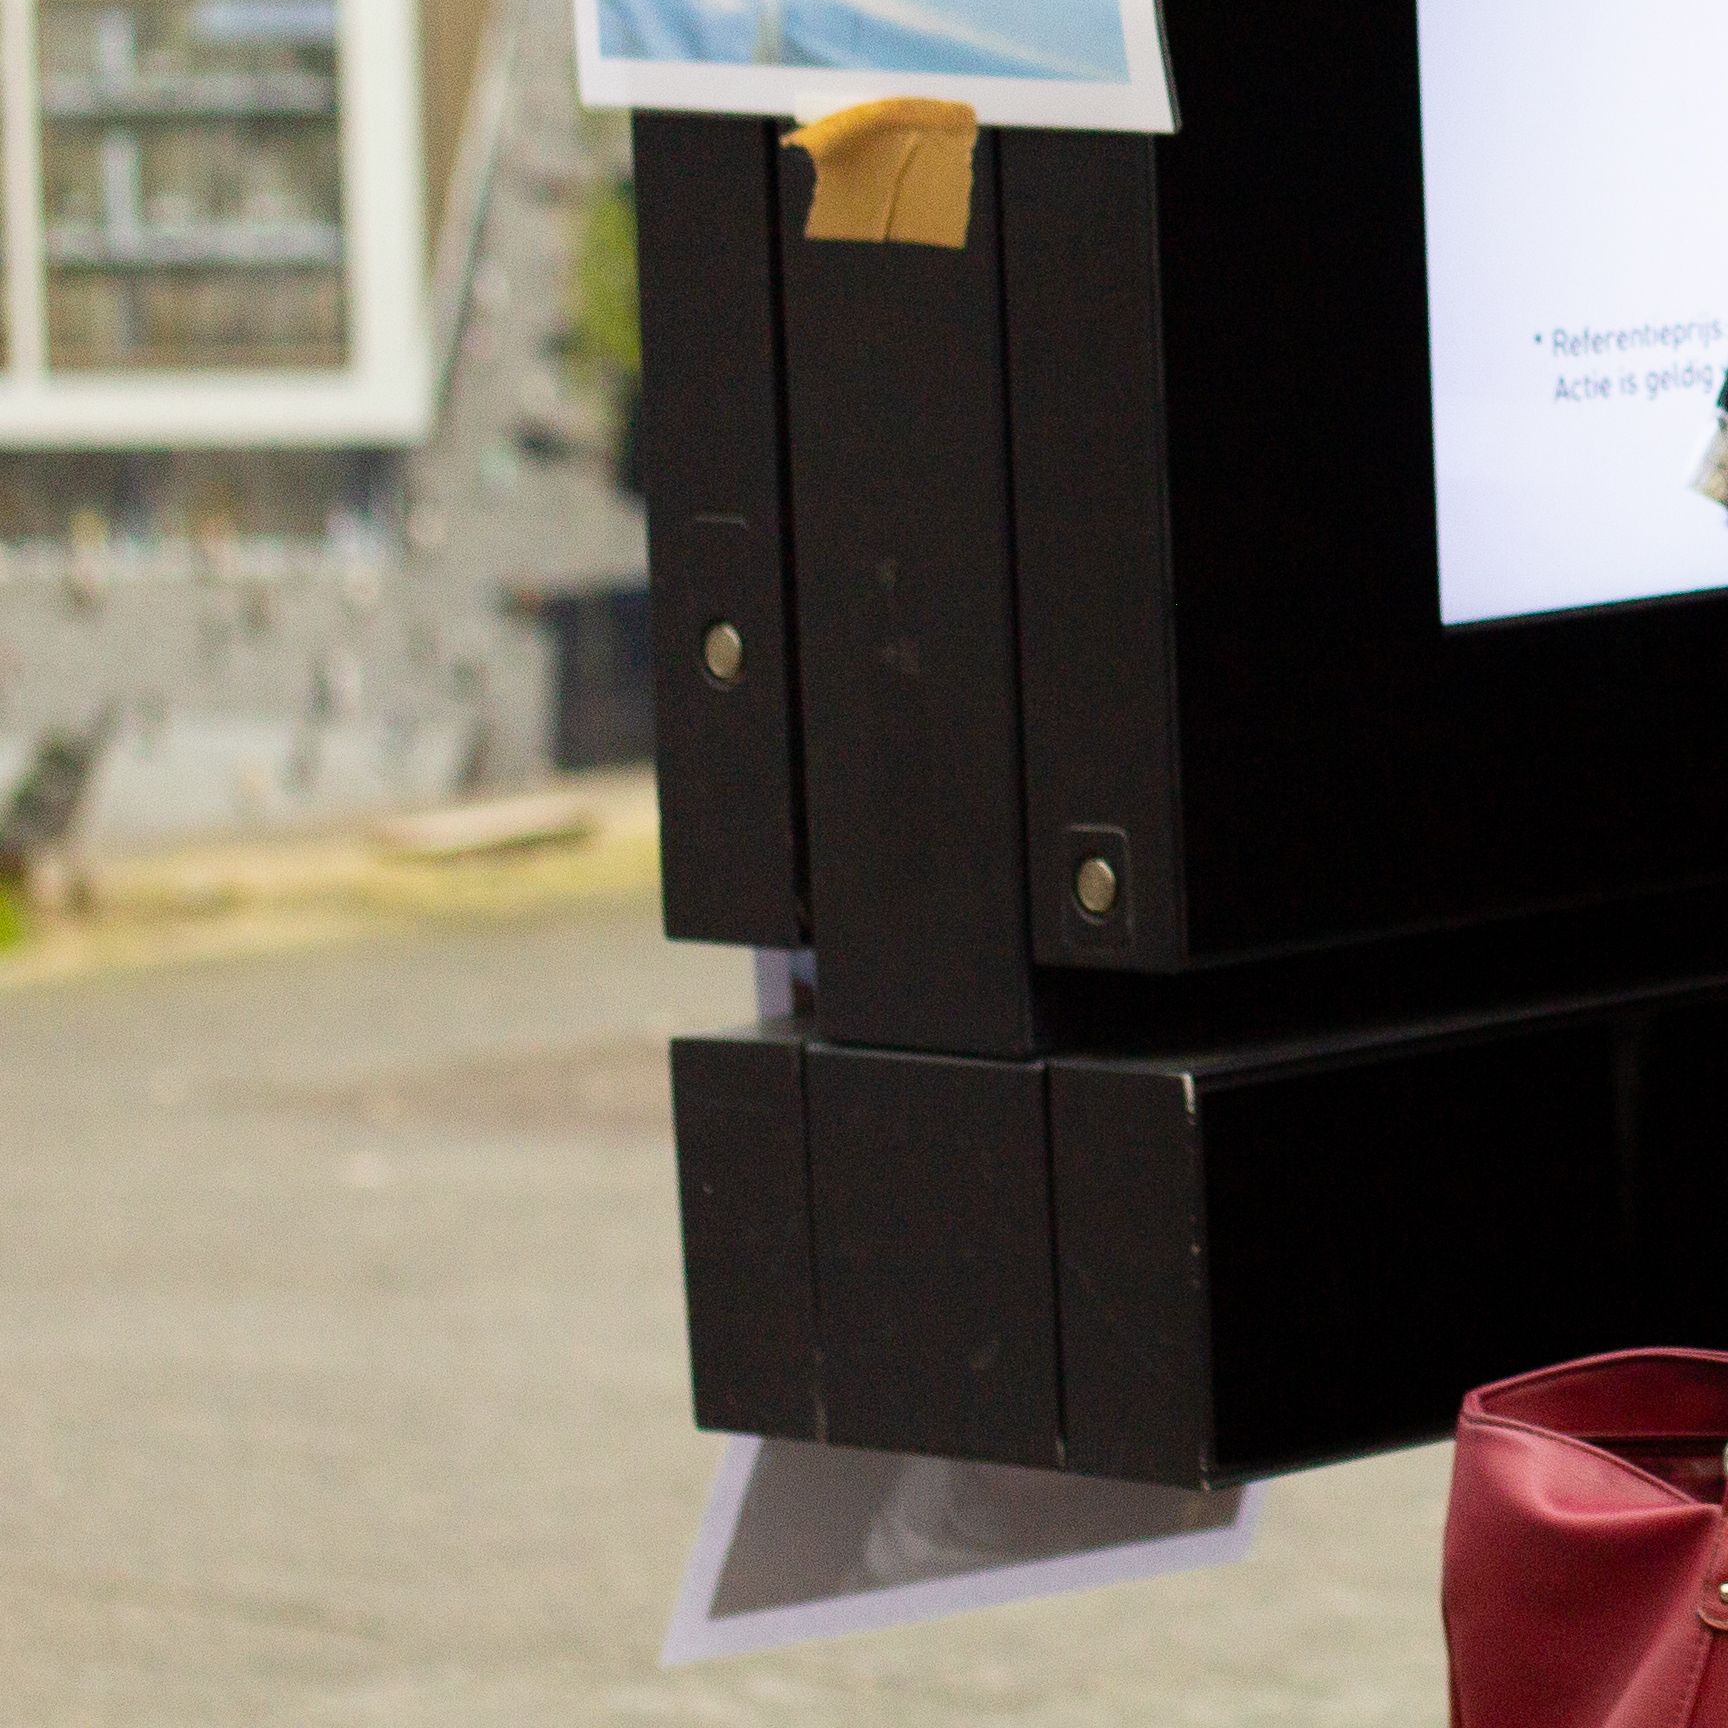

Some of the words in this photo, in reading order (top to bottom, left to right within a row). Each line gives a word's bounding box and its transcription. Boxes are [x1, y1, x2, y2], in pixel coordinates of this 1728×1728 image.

[1554, 371, 1612, 403] Actie
[1618, 367, 1638, 395] is
[1645, 361, 1714, 401] geldig
